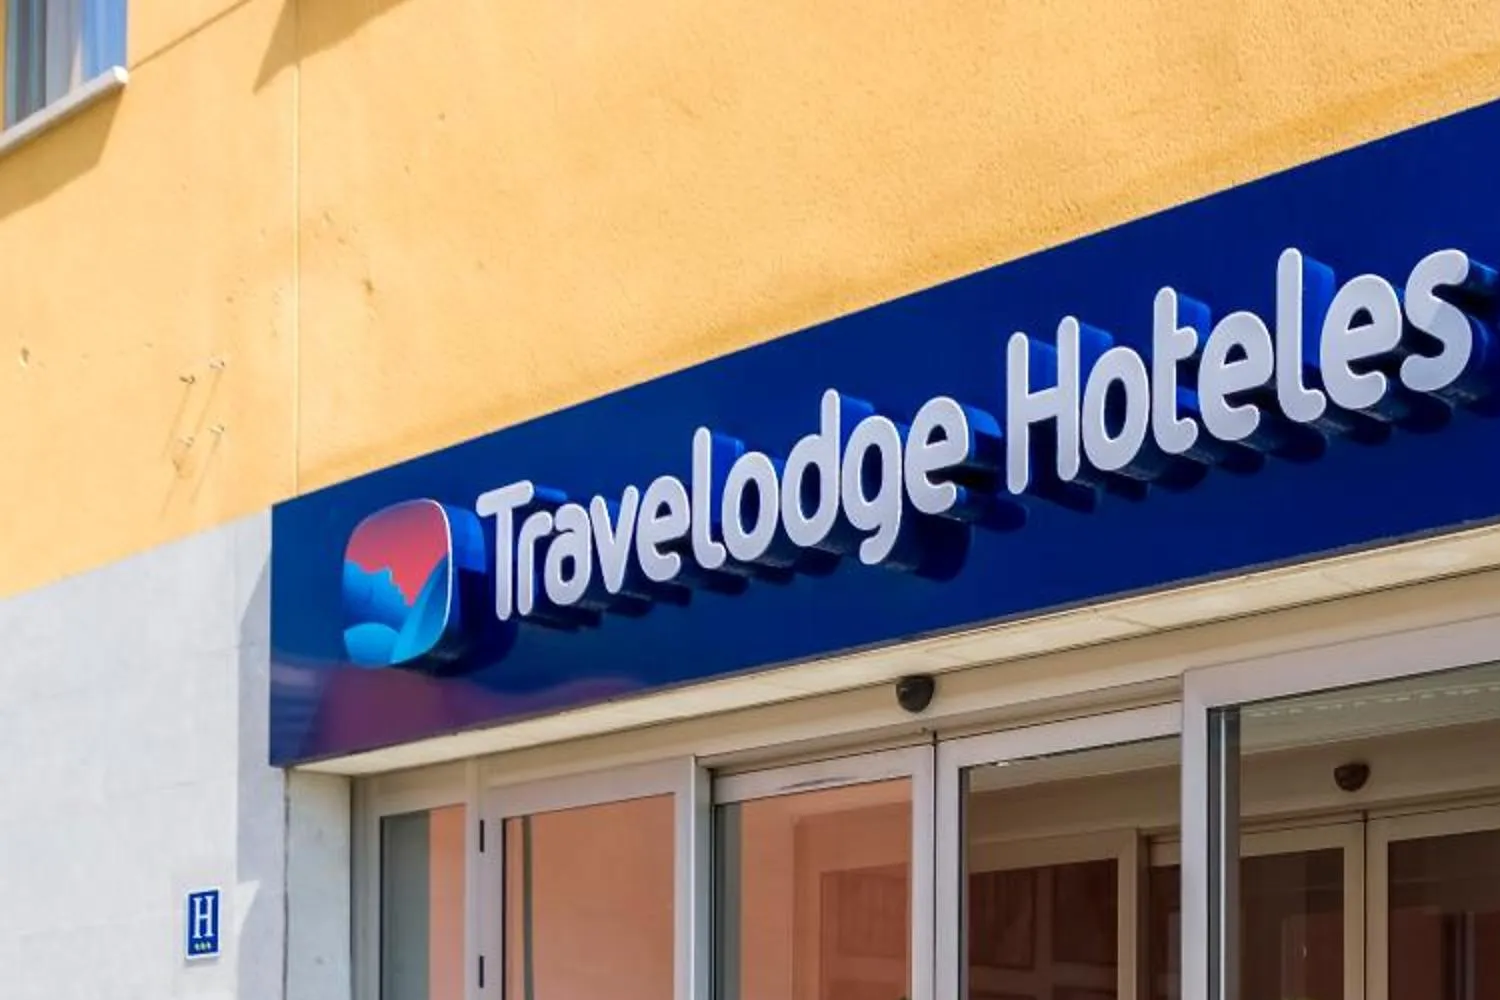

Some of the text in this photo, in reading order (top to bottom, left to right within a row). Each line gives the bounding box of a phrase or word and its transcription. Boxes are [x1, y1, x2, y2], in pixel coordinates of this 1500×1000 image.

[477, 247, 1473, 621] Travelodge Hoteles
[192, 895, 215, 939] H
